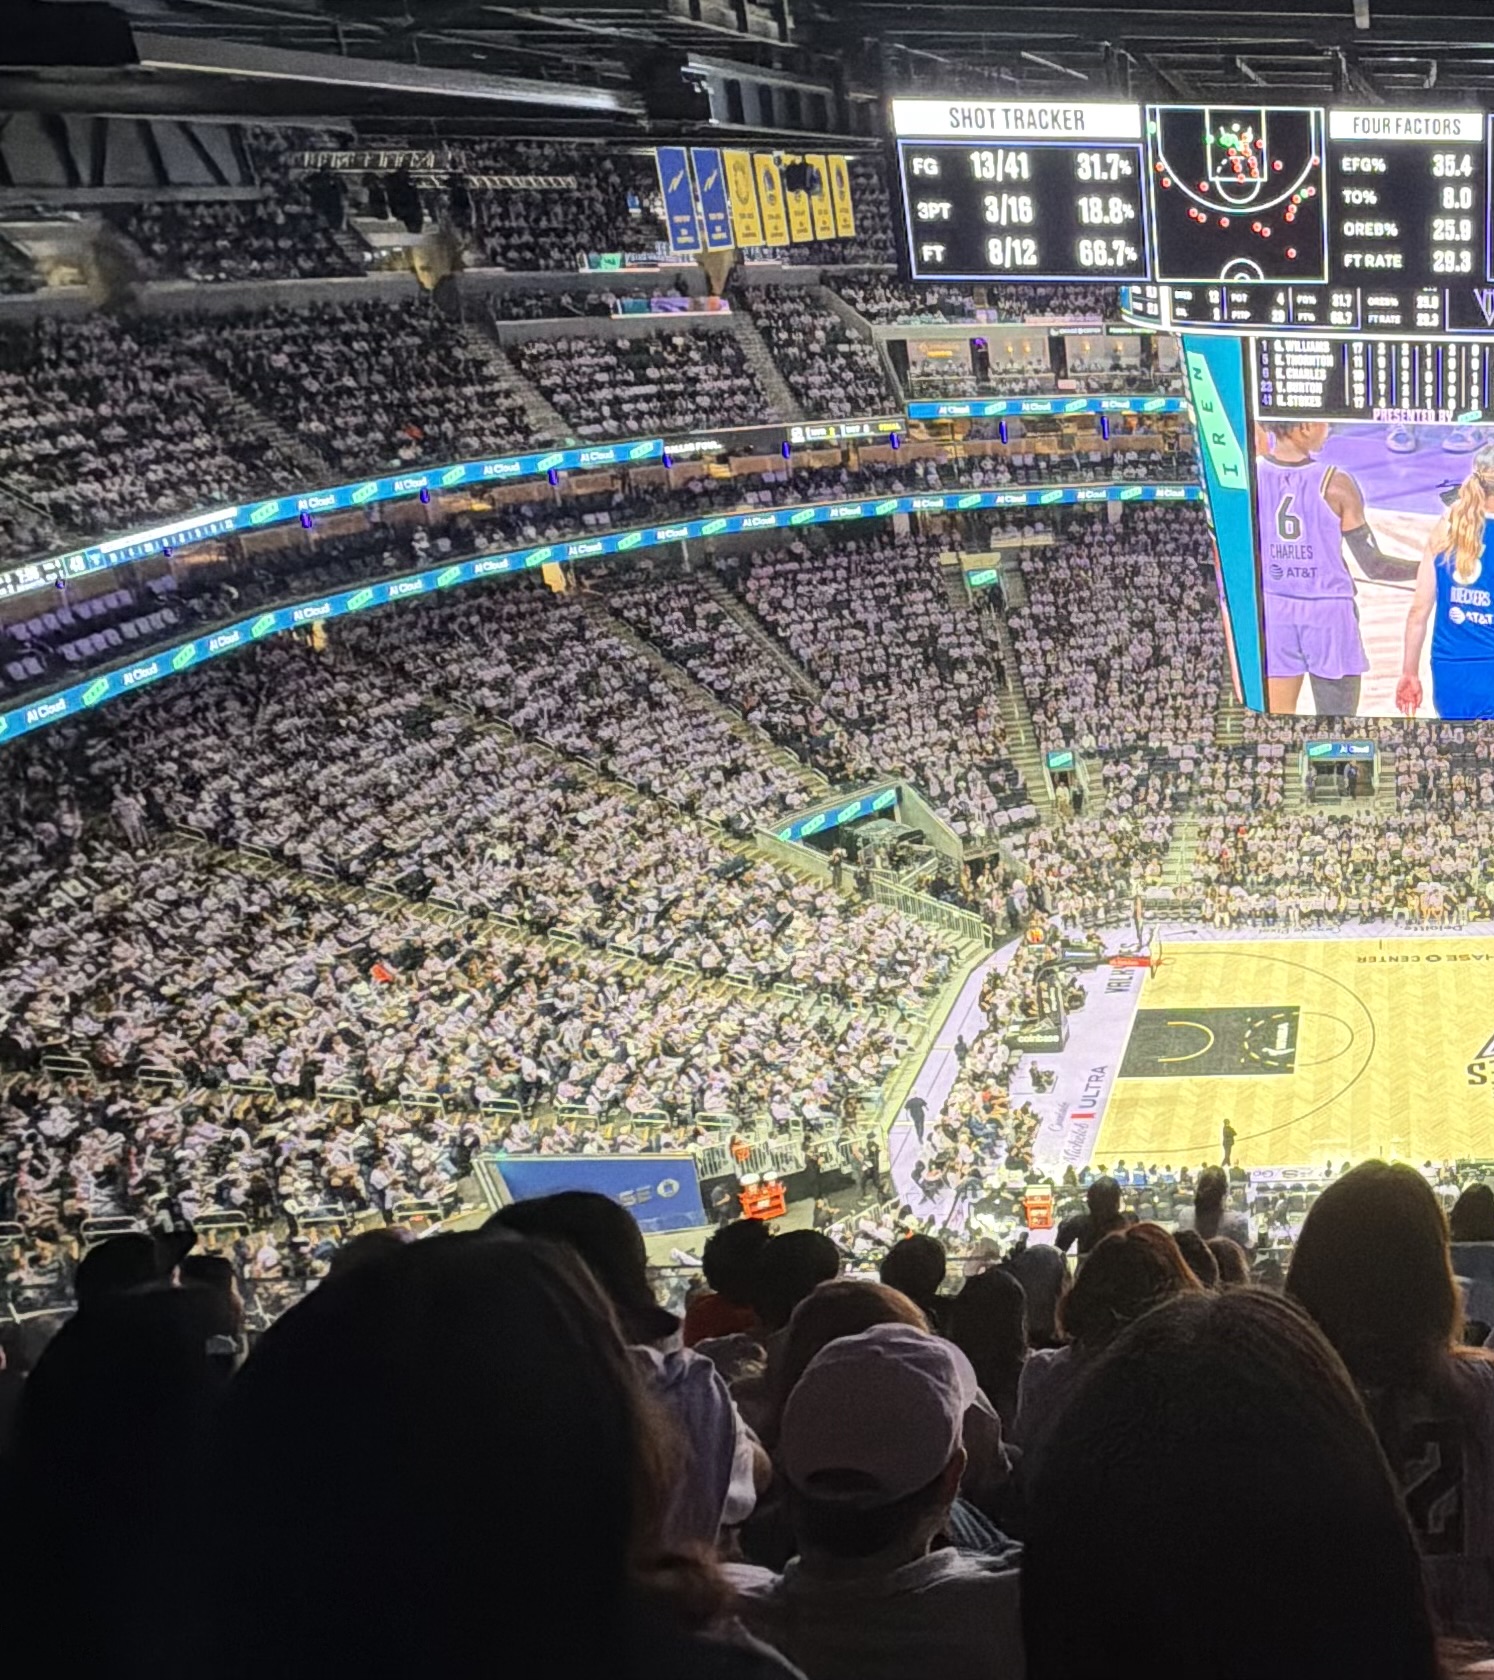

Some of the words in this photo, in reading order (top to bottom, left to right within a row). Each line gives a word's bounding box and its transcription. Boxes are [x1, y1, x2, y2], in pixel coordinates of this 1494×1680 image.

[949, 109, 999, 131] SHOT
[1002, 109, 1085, 132] TRACKER
[1353, 117, 1391, 136] FOUR
[1395, 118, 1461, 136] FACTORS
[913, 158, 939, 177] FG
[969, 153, 1029, 182] 13/41
[1076, 155, 1132, 182] 31.7%
[1341, 156, 1386, 173] EFG%
[1432, 154, 1473, 178] 35.4
[1343, 190, 1378, 206] TO%
[917, 203, 952, 220] 3PT
[984, 196, 1033, 224] 3/16
[1078, 196, 1134, 224] 18.8%
[1343, 221, 1399, 238] OREB%
[922, 246, 945, 263] FT
[988, 237, 1038, 266] 8/12
[1079, 238, 1137, 266] 66.7%
[1344, 253, 1364, 268] FT
[1366, 253, 1403, 269] RATE
[1367, 314, 1378, 324] FT
[1379, 314, 1402, 325] RATE
[1373, 408, 1437, 422] PRESENTED
[1439, 409, 1454, 422] BY
[590, 449, 614, 460] Cloud
[494, 462, 520, 474] Cloud
[404, 477, 428, 490] Cloud
[310, 495, 335, 509] Cloud
[1275, 494, 1303, 541] 6
[578, 541, 602, 554] Cloud
[1270, 544, 1313, 560] CHARLES
[485, 559, 509, 571] Cloud
[1286, 566, 1318, 579] AT&T
[400, 580, 422, 593] Cloud
[305, 603, 330, 618] Cloud
[1465, 611, 1494, 625] AT&T
[219, 631, 240, 647] Cloud
[135, 664, 158, 681] Cloud
[39, 699, 66, 718] Cloud
[1356, 955, 1421, 963] CENTER
[1078, 1065, 1108, 1108] ULTRA
